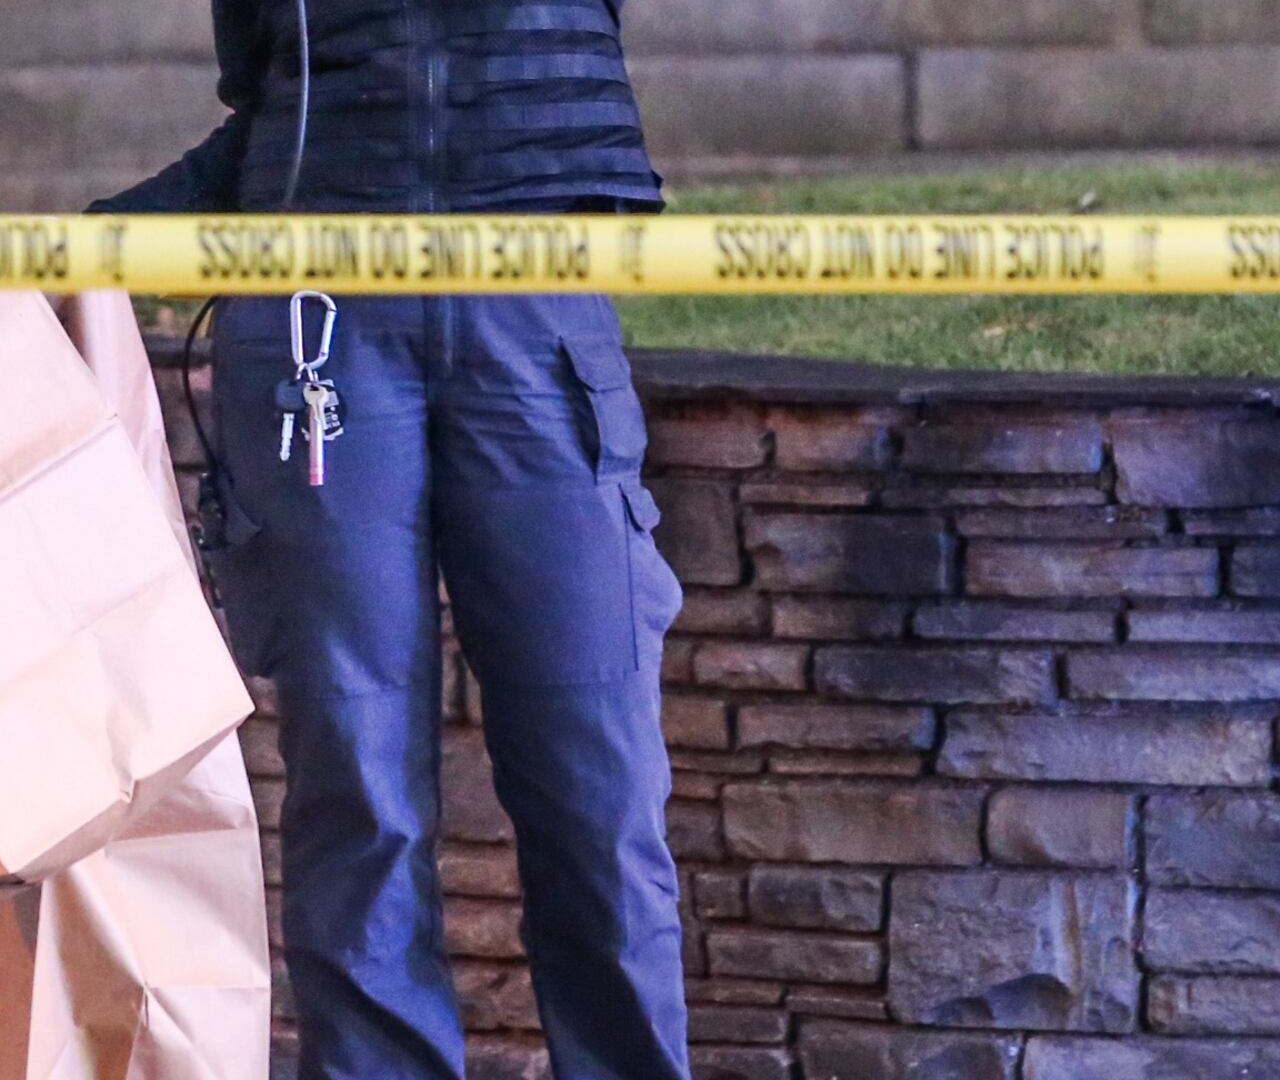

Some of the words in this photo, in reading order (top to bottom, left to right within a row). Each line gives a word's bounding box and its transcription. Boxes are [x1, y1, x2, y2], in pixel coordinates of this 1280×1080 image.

[198, 222, 295, 279] CROSS
[304, 222, 359, 279] NOT
[371, 222, 408, 279] DO
[420, 222, 482, 279] LINE
[492, 222, 590, 279] POLICE
[715, 223, 811, 280] CROSS
[820, 223, 874, 280] NOT
[885, 223, 921, 280] DO
[933, 223, 995, 280] LINE
[1004, 223, 1103, 280] POLICE
